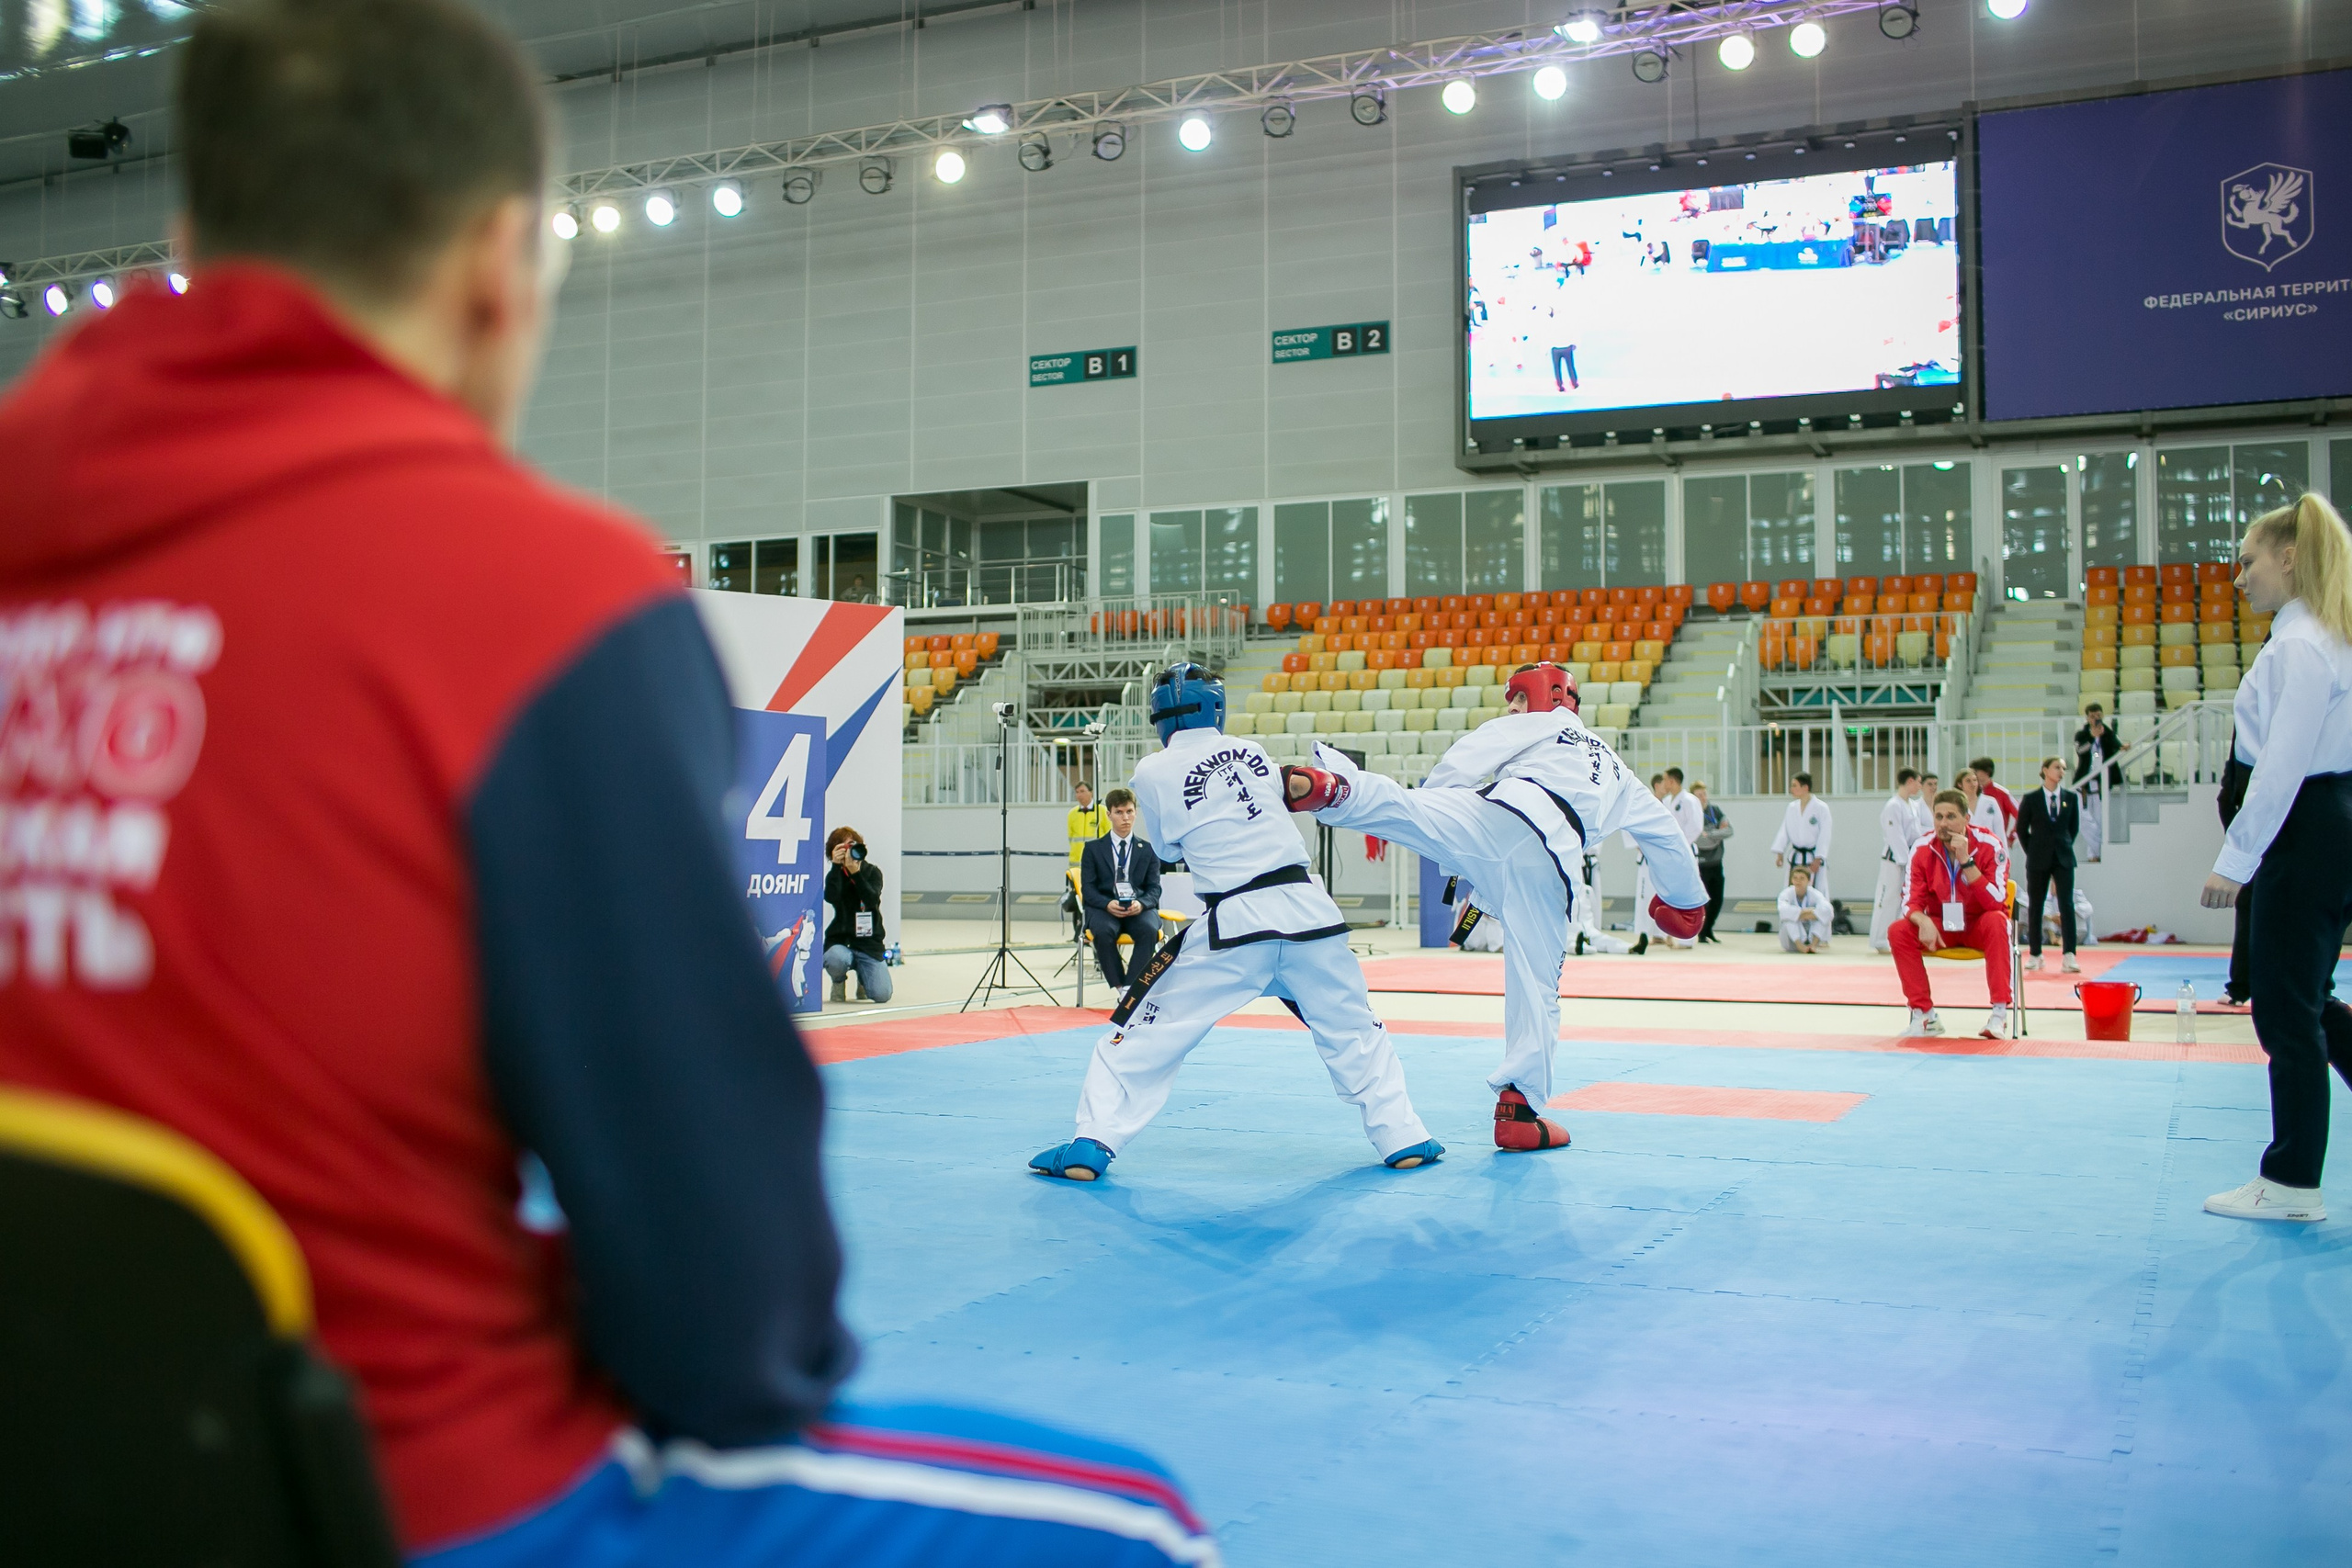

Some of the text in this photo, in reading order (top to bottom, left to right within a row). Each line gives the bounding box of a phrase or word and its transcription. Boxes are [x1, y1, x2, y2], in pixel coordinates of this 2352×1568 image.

[2143, 278, 2352, 310] ФЕДЕРАЛЬНАЯ ТЕРРИТ
[2223, 303, 2319, 321] «СИРИУС»
[1274, 333, 1318, 346] СЕКТОР
[1367, 329, 1381, 347] 2
[1274, 347, 1311, 358] SECTOR
[1031, 357, 1072, 370] СЕКТОР
[1117, 354, 1127, 371] 1
[1031, 371, 1065, 382] SECTOR
[1217, 763, 1234, 777] ITF
[1183, 748, 1270, 811] TAEKWON-DO
[745, 732, 812, 864] 4
[746, 874, 810, 898] ДОЯНГ
[1146, 1001, 1160, 1014] ITF
